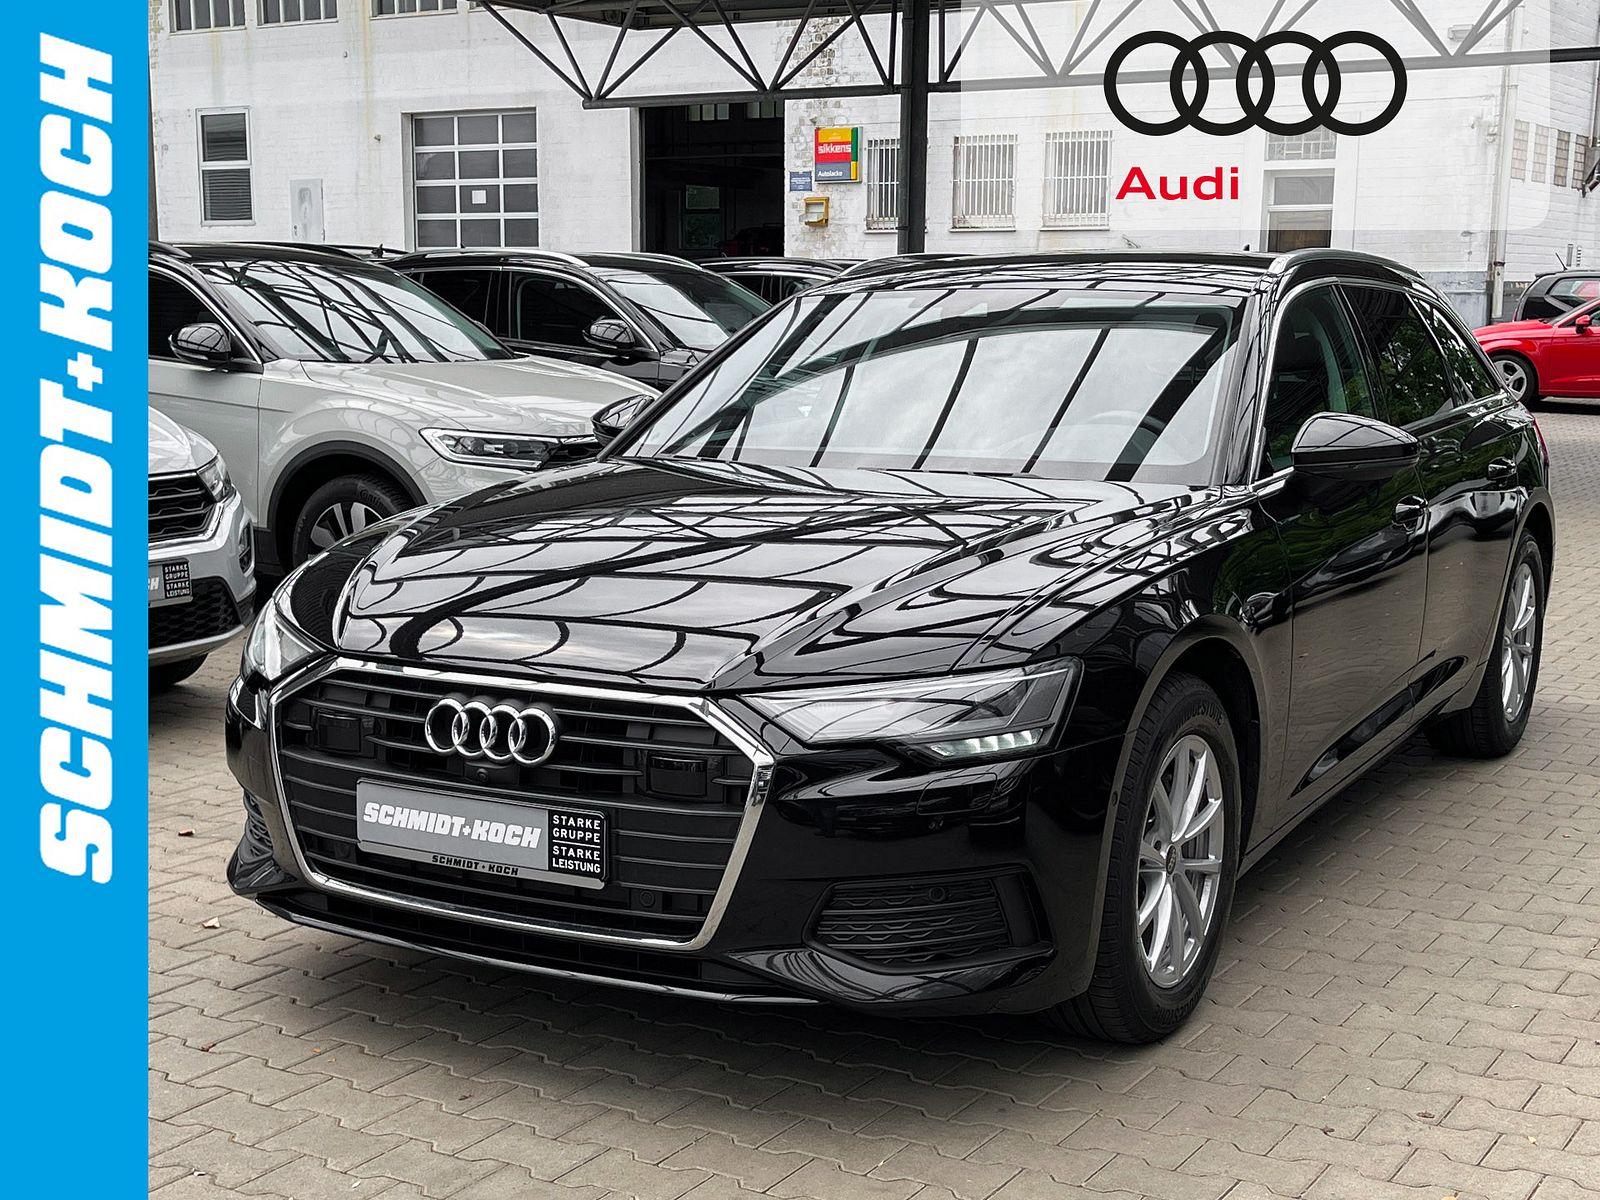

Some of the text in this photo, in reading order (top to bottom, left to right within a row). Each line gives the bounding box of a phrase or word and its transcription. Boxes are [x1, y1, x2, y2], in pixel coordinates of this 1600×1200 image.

[818, 144, 852, 154] sikkens
[363, 802, 541, 848] SCHMIDT+KOCH
[552, 814, 600, 829] STARKE
[552, 828, 600, 842] GRUPPE
[552, 845, 600, 860] STARKE
[432, 855, 479, 869] SCHMIDT
[488, 864, 519, 876] KOCH
[552, 858, 600, 873] LEISTUNG
